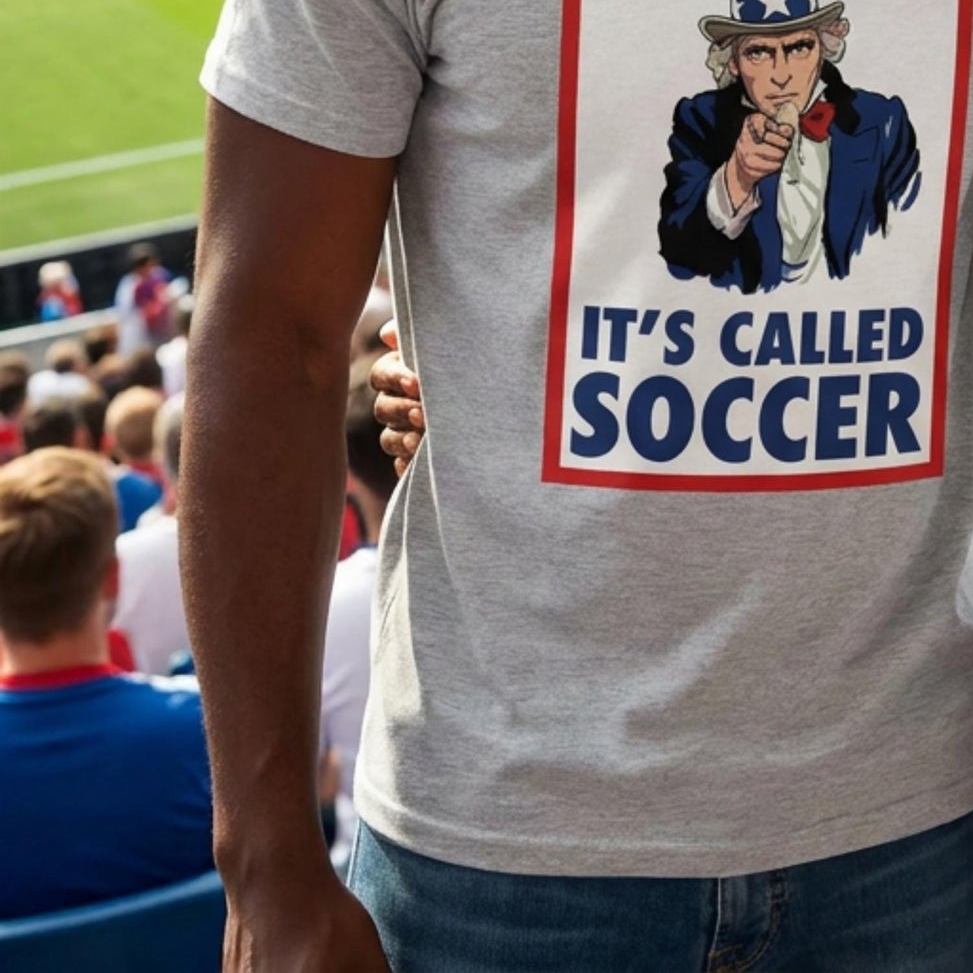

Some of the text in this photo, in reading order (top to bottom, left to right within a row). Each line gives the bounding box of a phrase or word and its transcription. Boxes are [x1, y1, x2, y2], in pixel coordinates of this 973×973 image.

[581, 305, 924, 367] IT'S CALLED
[569, 371, 922, 464] SOCCER
